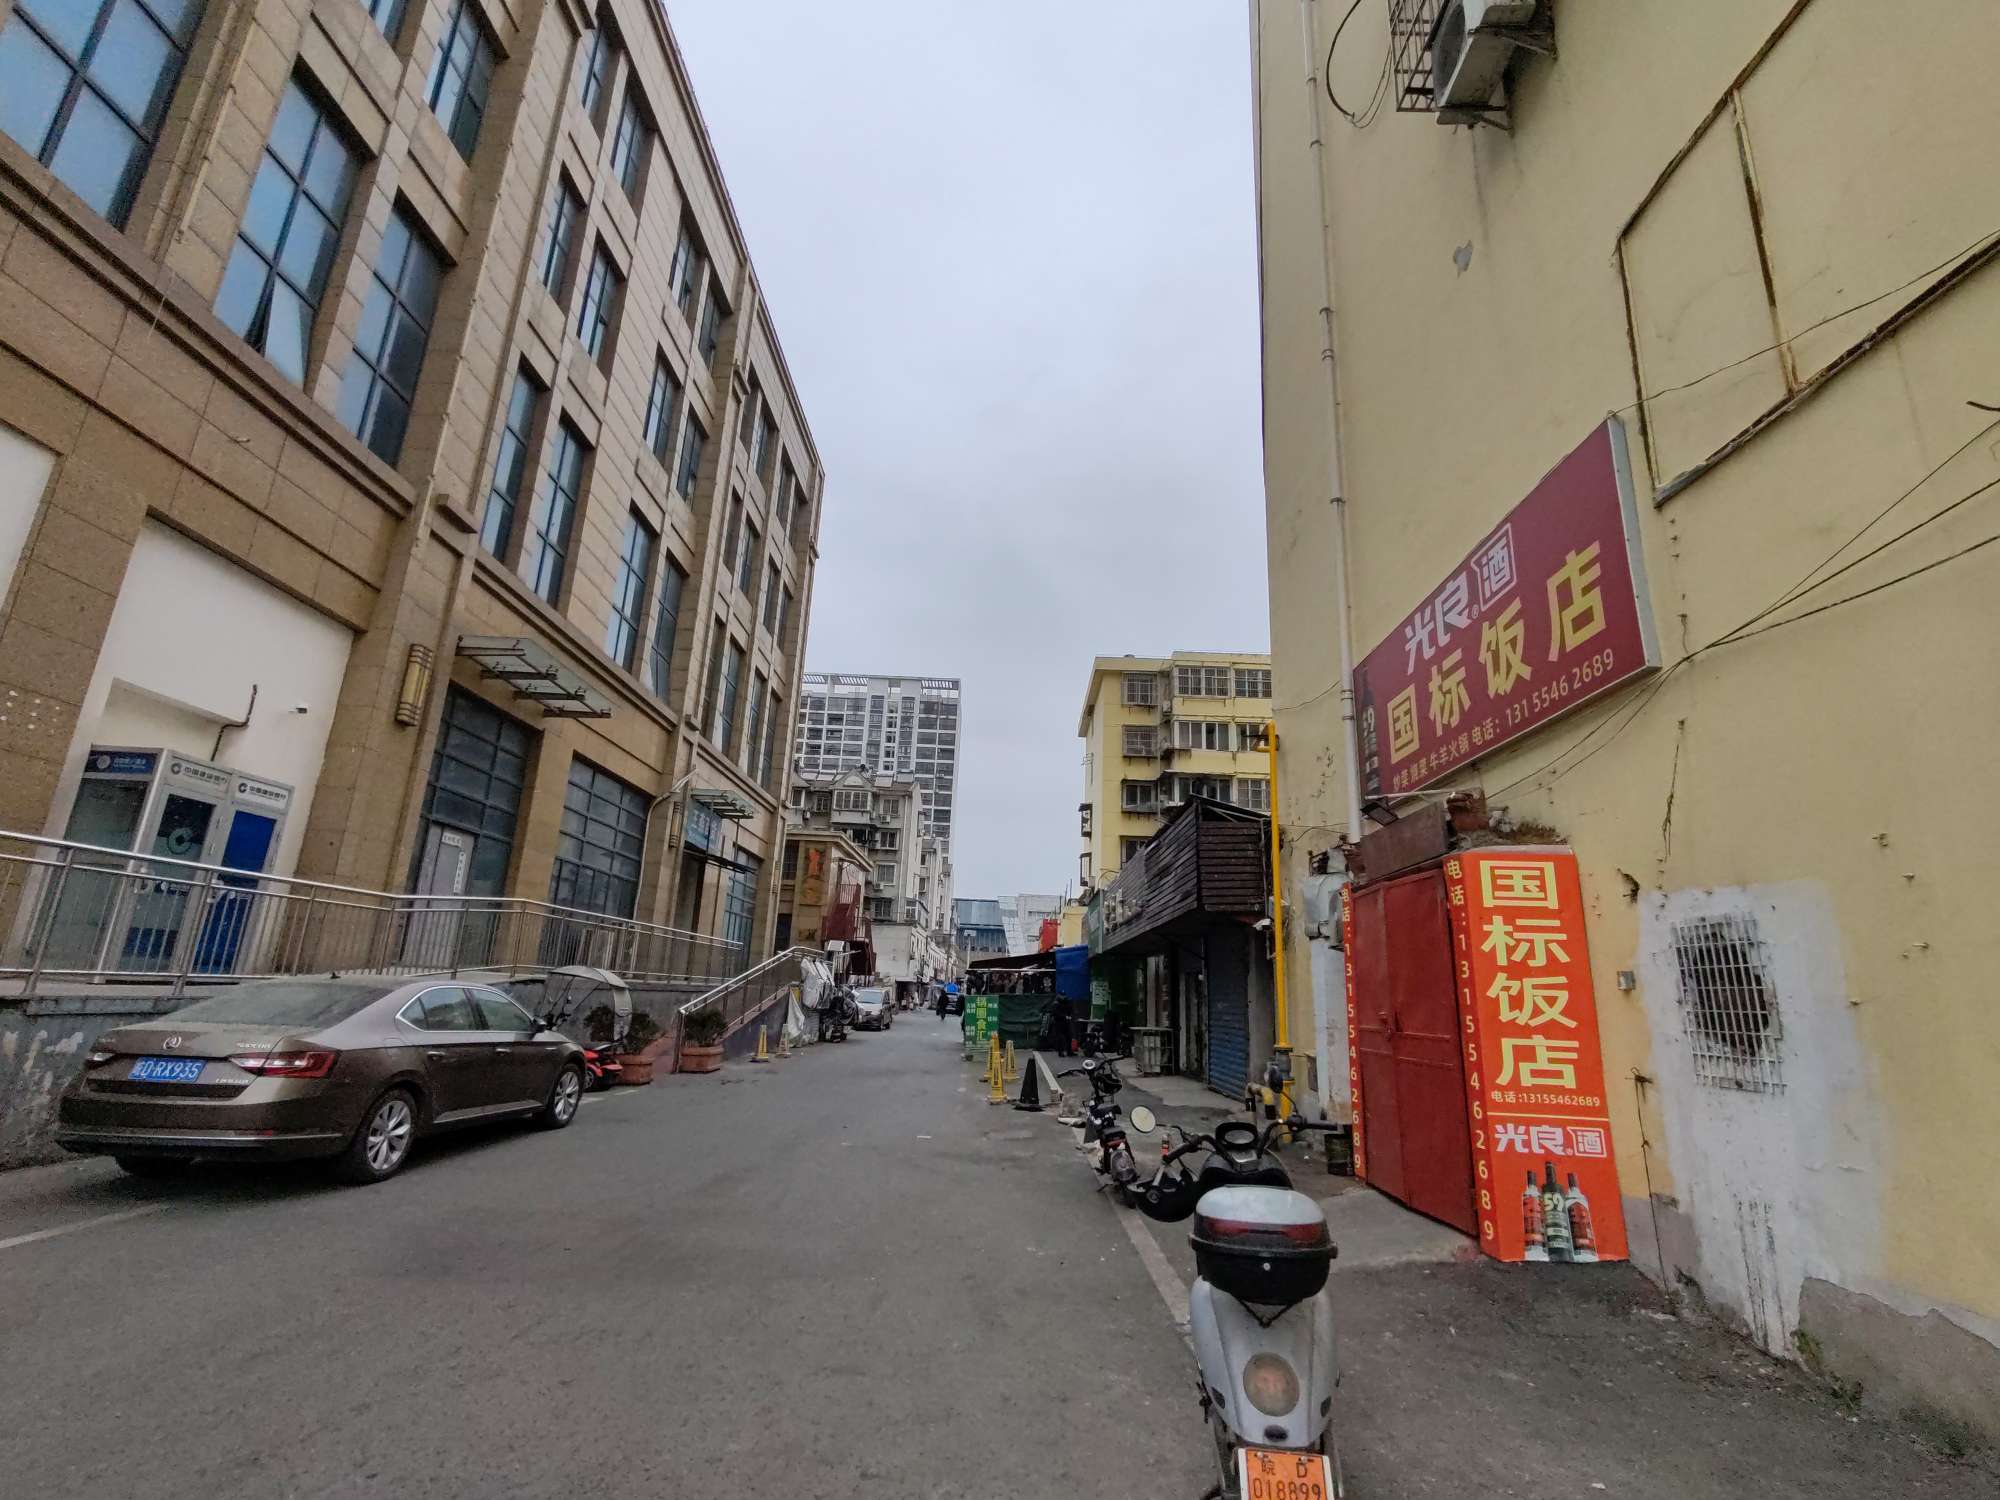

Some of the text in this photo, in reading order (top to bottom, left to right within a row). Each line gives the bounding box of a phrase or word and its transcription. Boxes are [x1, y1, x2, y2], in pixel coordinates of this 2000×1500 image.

[1387, 541, 1607, 765] 国标饭店
[1533, 673, 1569, 713] 5546
[1572, 647, 1615, 687] 2689
[1480, 860, 1579, 1089] 国标饭店
[1543, 1192, 1564, 1211] 59
[1253, 1478, 1321, 1500] 018899
[1296, 1461, 1308, 1478] D
